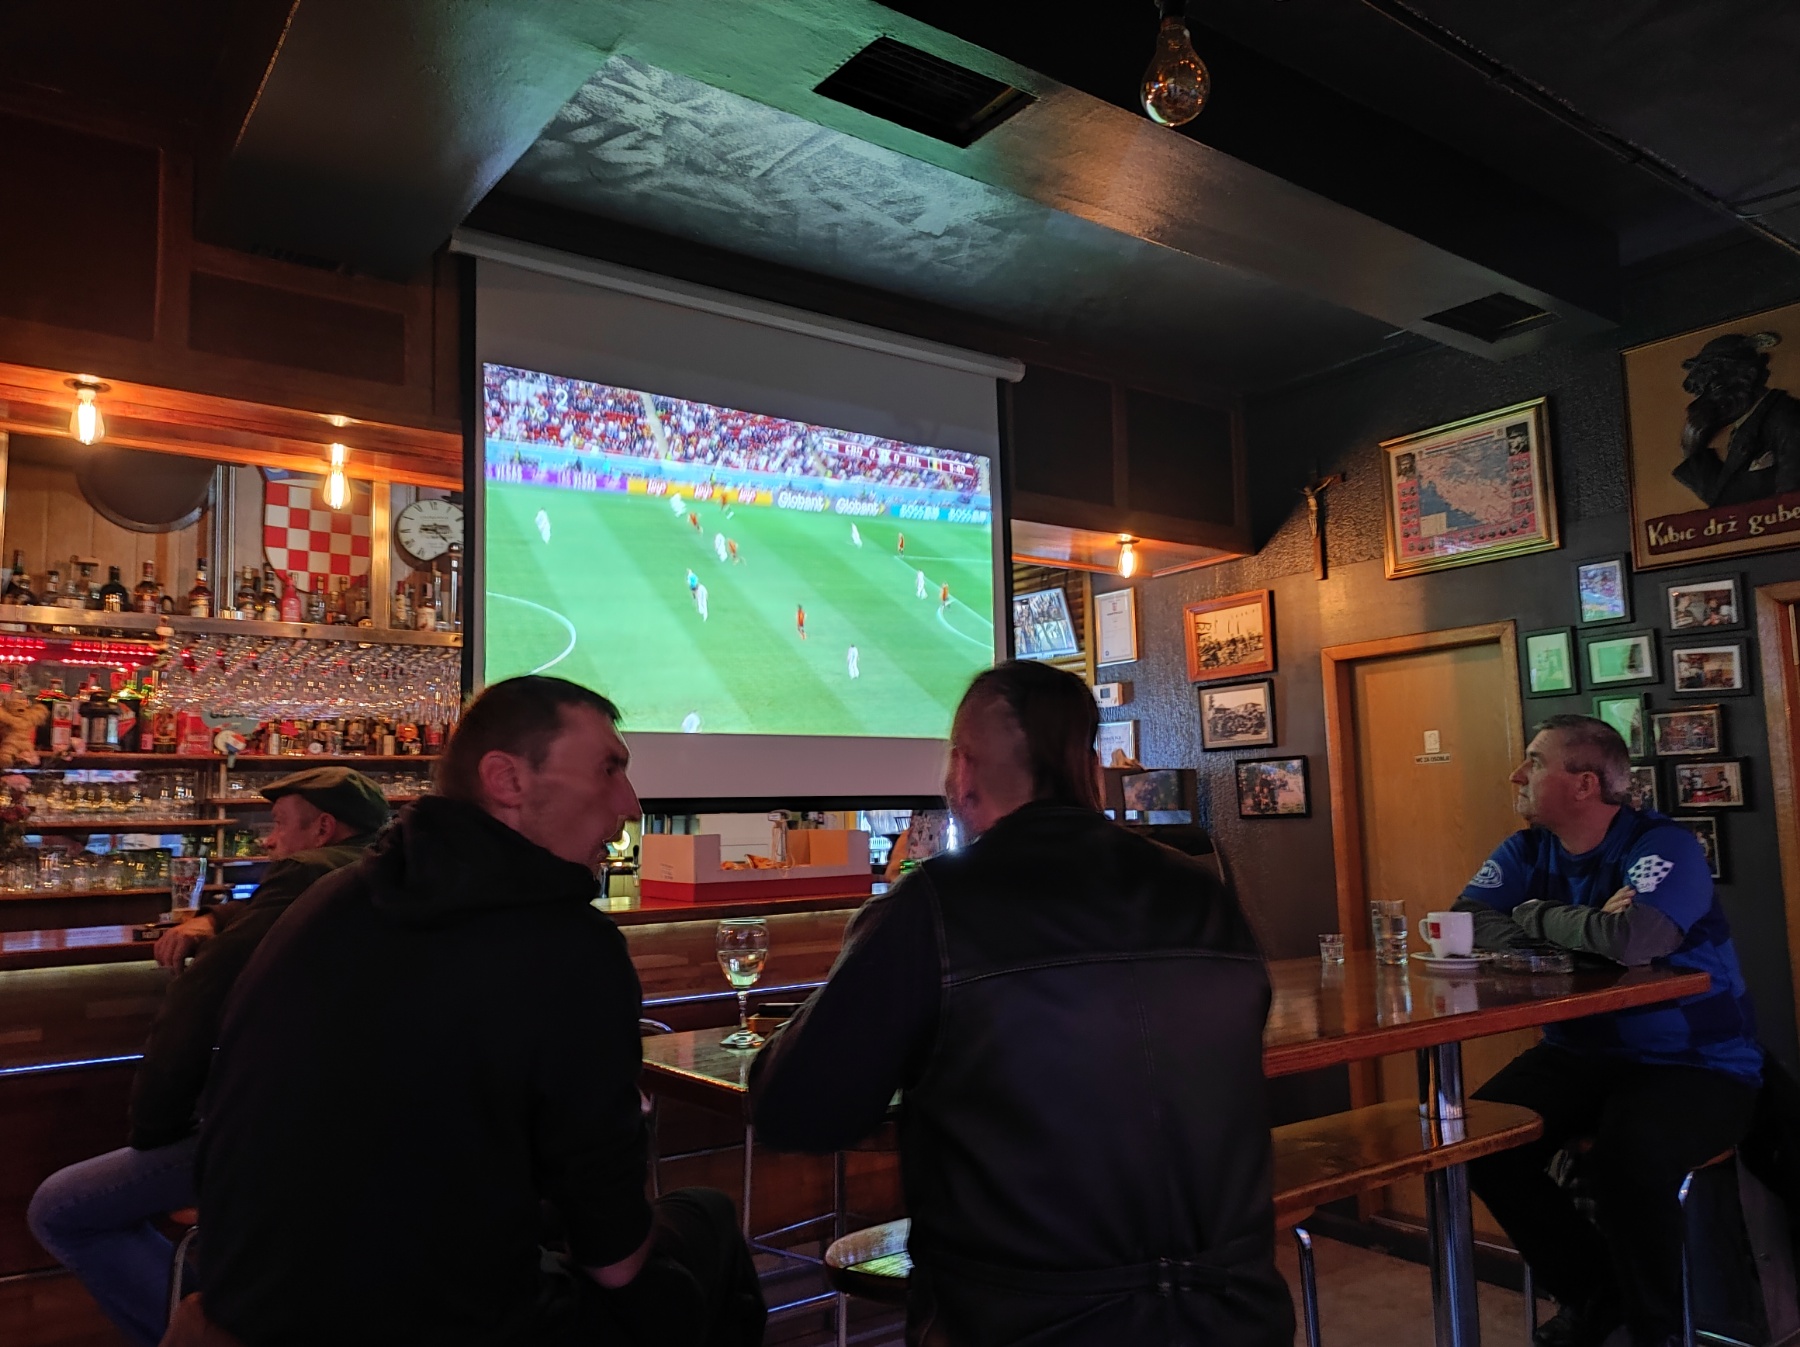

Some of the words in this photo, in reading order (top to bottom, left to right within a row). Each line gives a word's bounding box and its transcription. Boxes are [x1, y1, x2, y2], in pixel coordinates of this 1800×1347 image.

[905, 455, 922, 468] BEL
[777, 490, 825, 512] Globant
[834, 497, 880, 517] Globant
[1703, 515, 1738, 536] drž
